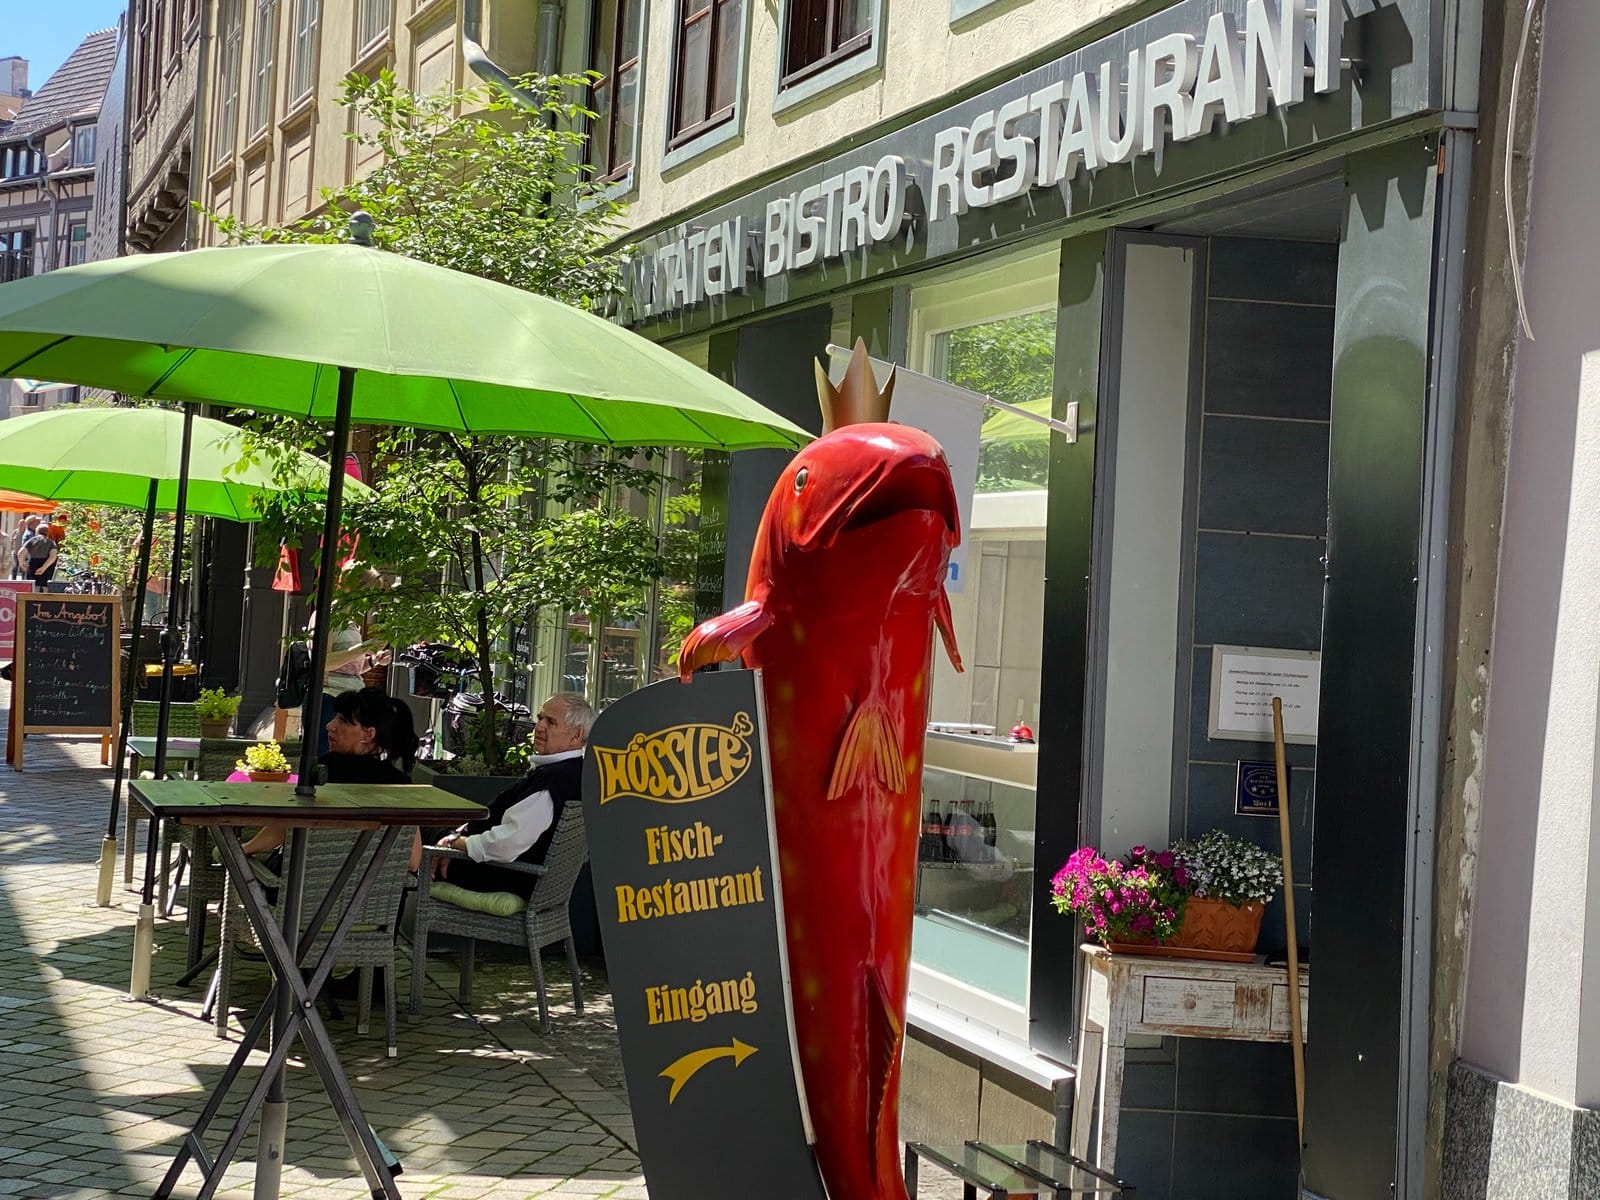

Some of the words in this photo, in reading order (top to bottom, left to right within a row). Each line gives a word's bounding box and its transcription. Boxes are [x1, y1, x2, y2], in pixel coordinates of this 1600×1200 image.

[764, 154, 906, 278] BISTRO
[930, 0, 1342, 222] RESTAURANT
[53, 603, 108, 625] Angebot
[645, 821, 723, 865] Fisch-
[615, 865, 764, 923] Restaurant
[645, 971, 758, 1025] Eingang
